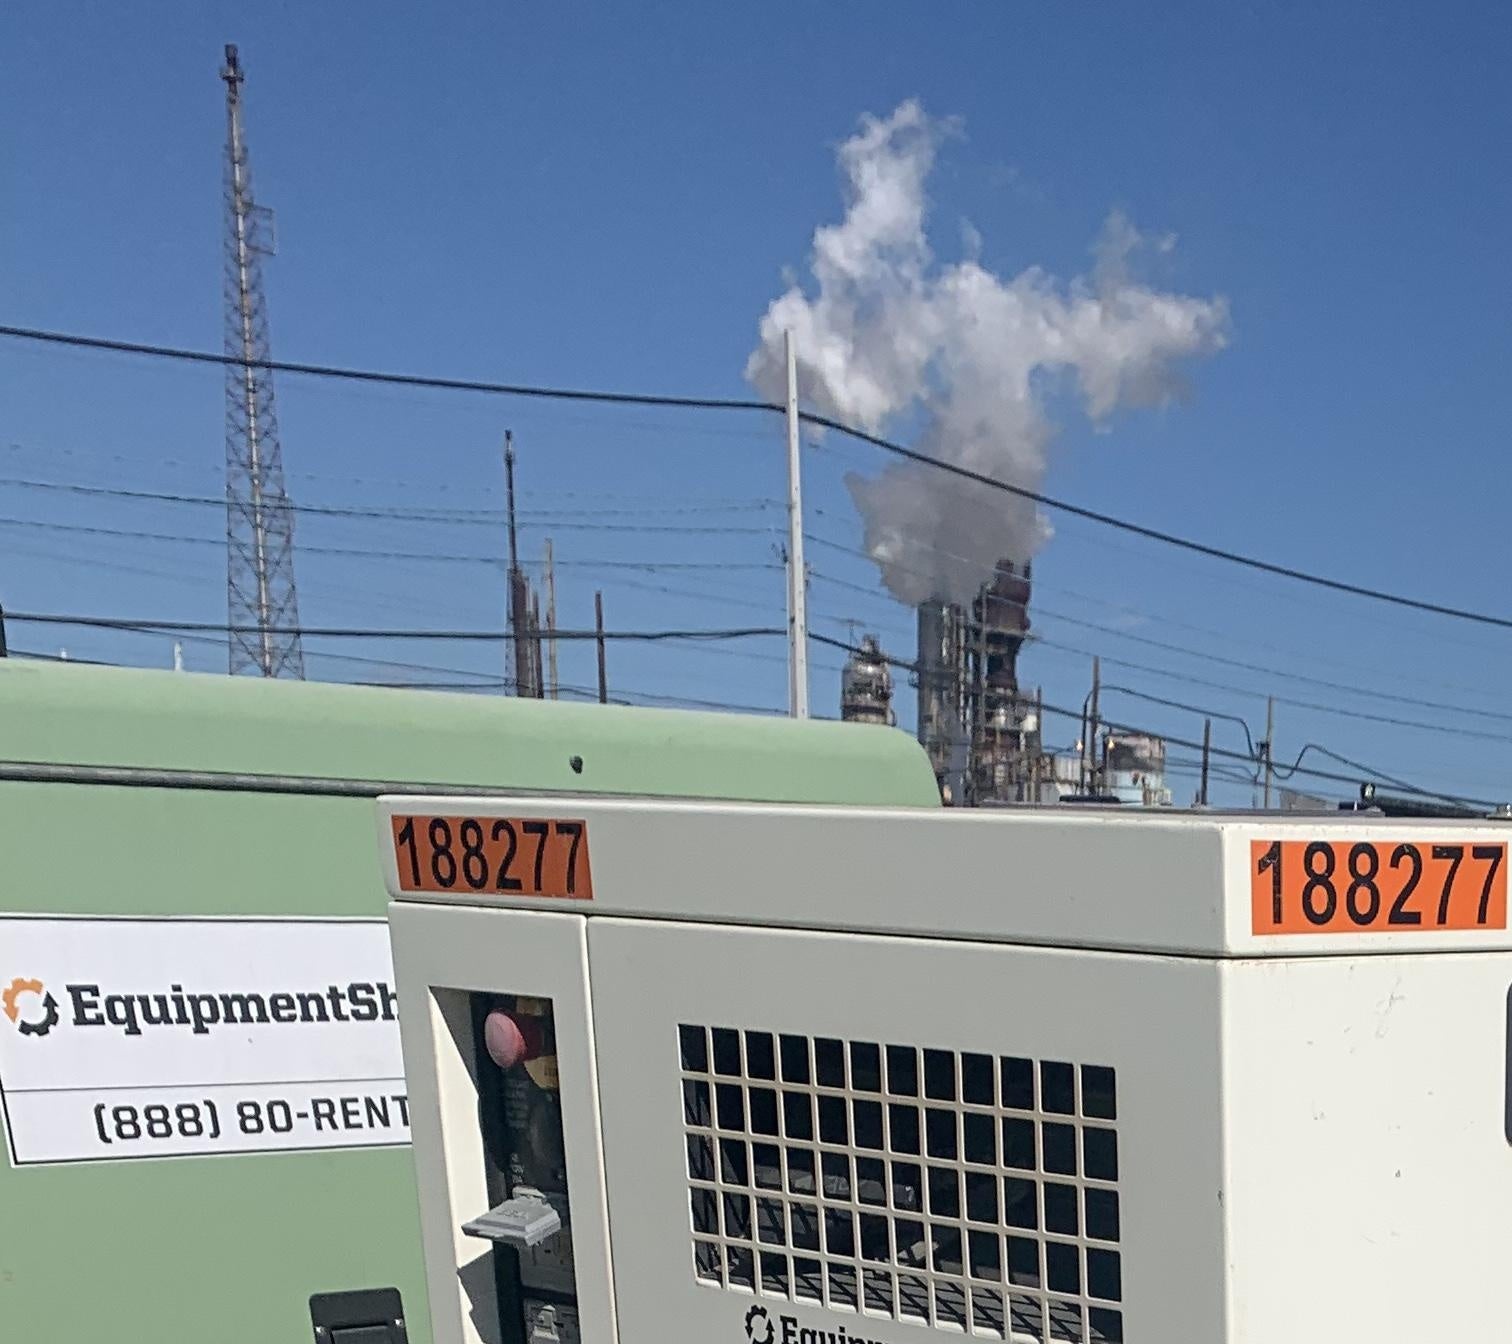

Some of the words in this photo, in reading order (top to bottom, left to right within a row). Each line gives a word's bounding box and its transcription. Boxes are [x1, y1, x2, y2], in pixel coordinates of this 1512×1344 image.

[399, 816, 582, 894] 188277
[1258, 841, 1503, 925] 188277
[94, 1099, 221, 1144] (888)
